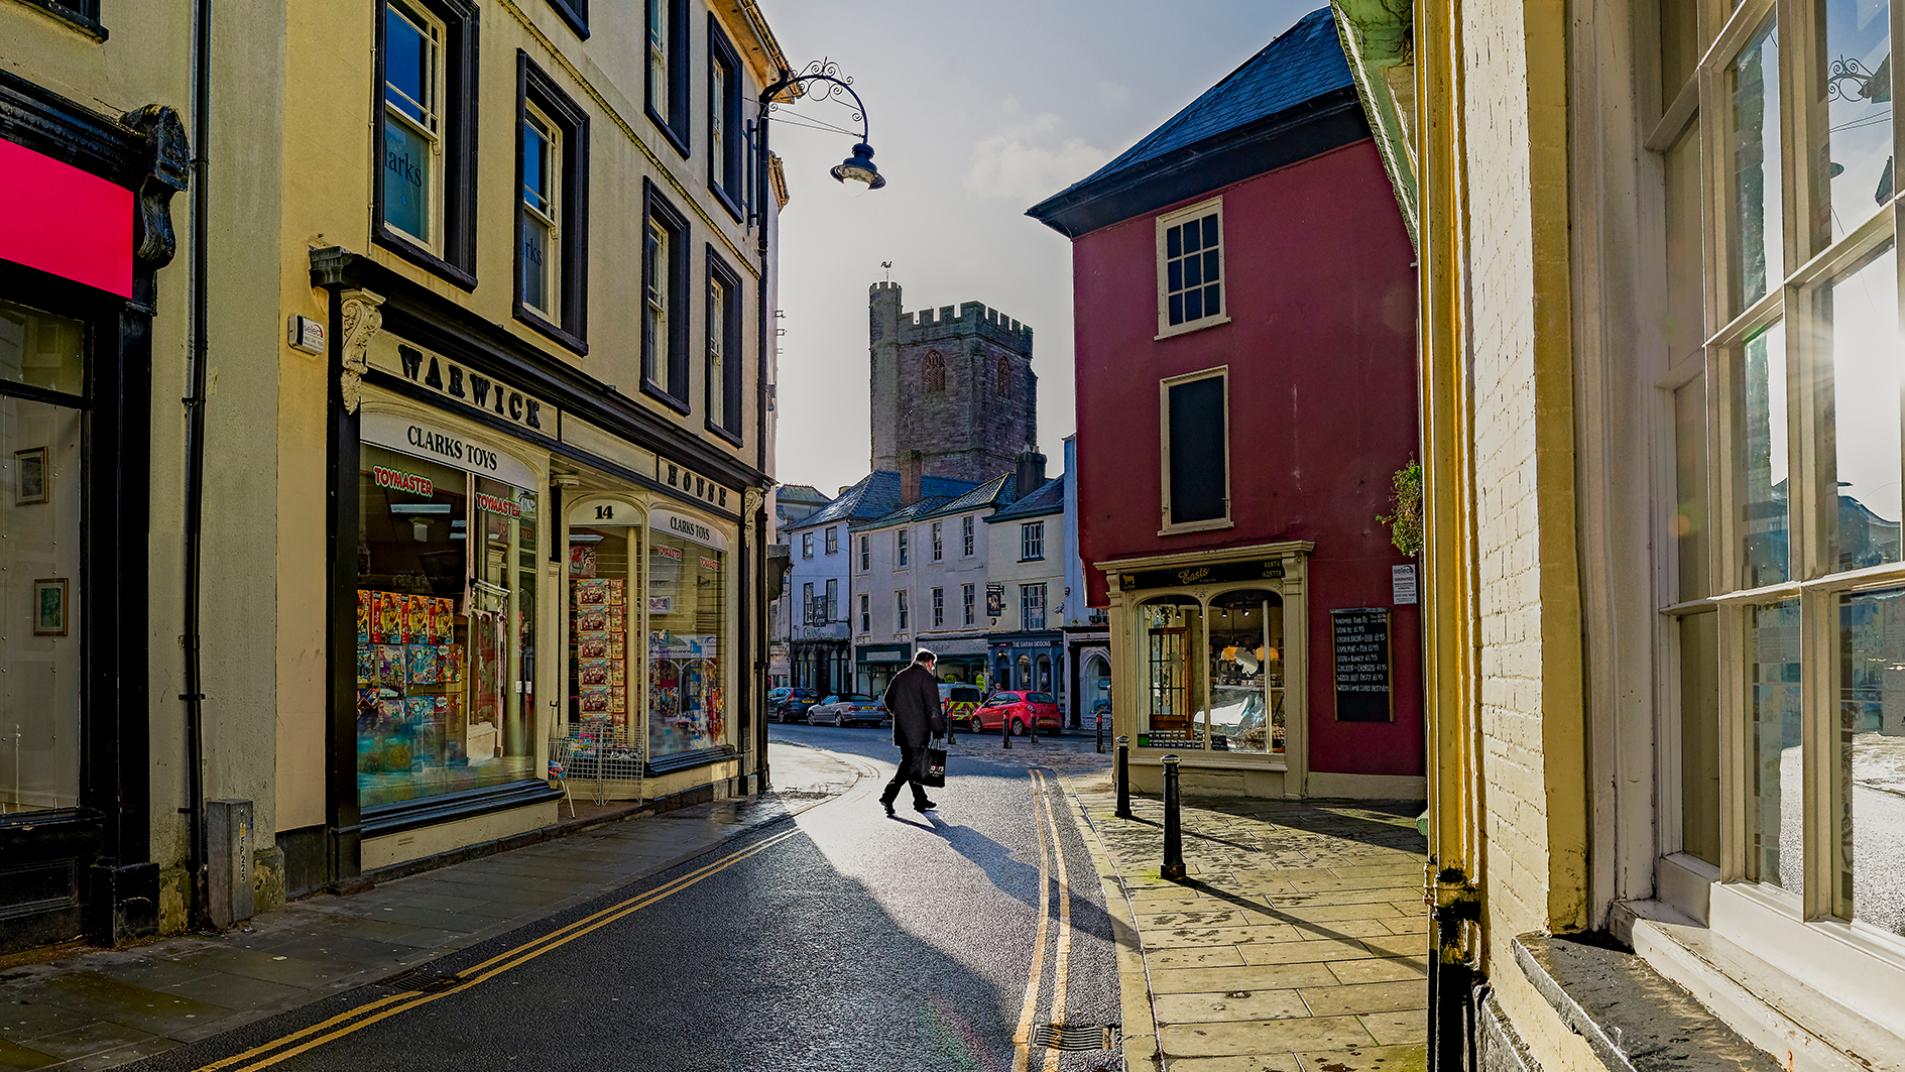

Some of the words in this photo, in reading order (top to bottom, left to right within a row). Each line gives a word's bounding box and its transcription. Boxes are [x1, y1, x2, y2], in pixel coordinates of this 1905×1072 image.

[398, 344, 540, 429] WARWICK
[407, 425, 463, 459] CLARKS
[466, 443, 498, 471] TOYS
[373, 464, 434, 497] TOYMASTER
[667, 464, 727, 507] HOUSE
[476, 493, 521, 519] TOYMASTER
[595, 505, 614, 520] 14
[670, 516, 695, 536] CLARKS
[695, 524, 710, 540] TOYS
